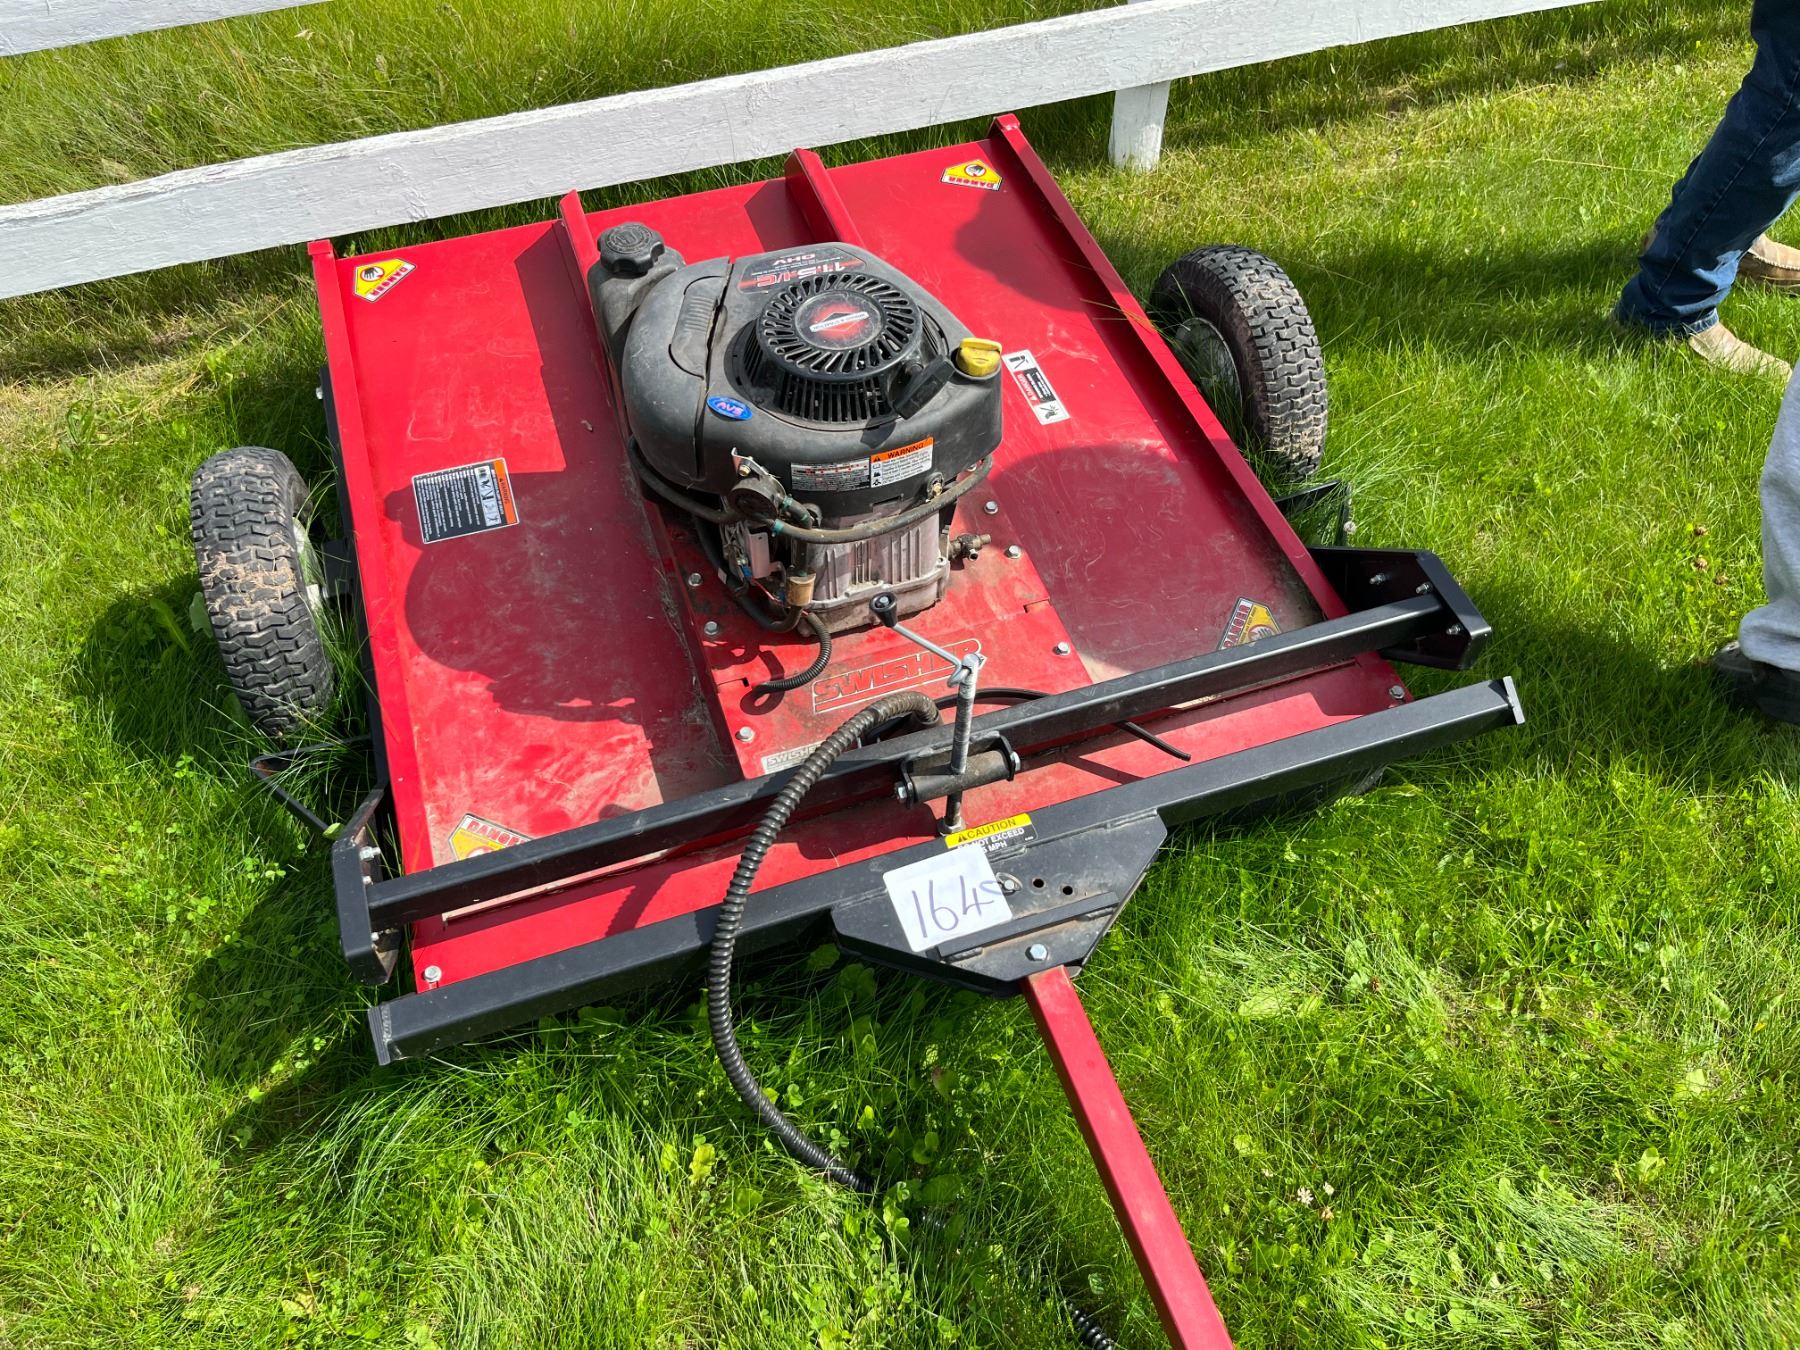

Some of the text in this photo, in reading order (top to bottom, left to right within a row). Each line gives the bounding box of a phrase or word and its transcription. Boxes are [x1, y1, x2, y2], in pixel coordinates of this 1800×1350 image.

[948, 176, 995, 189] DANGER
[772, 253, 816, 265] OHV
[370, 266, 409, 296] DANGER
[886, 443, 925, 460] WARNING
[966, 818, 1017, 839] CAUTION
[990, 827, 1025, 843] EXCEED
[988, 841, 1008, 851] MPH
